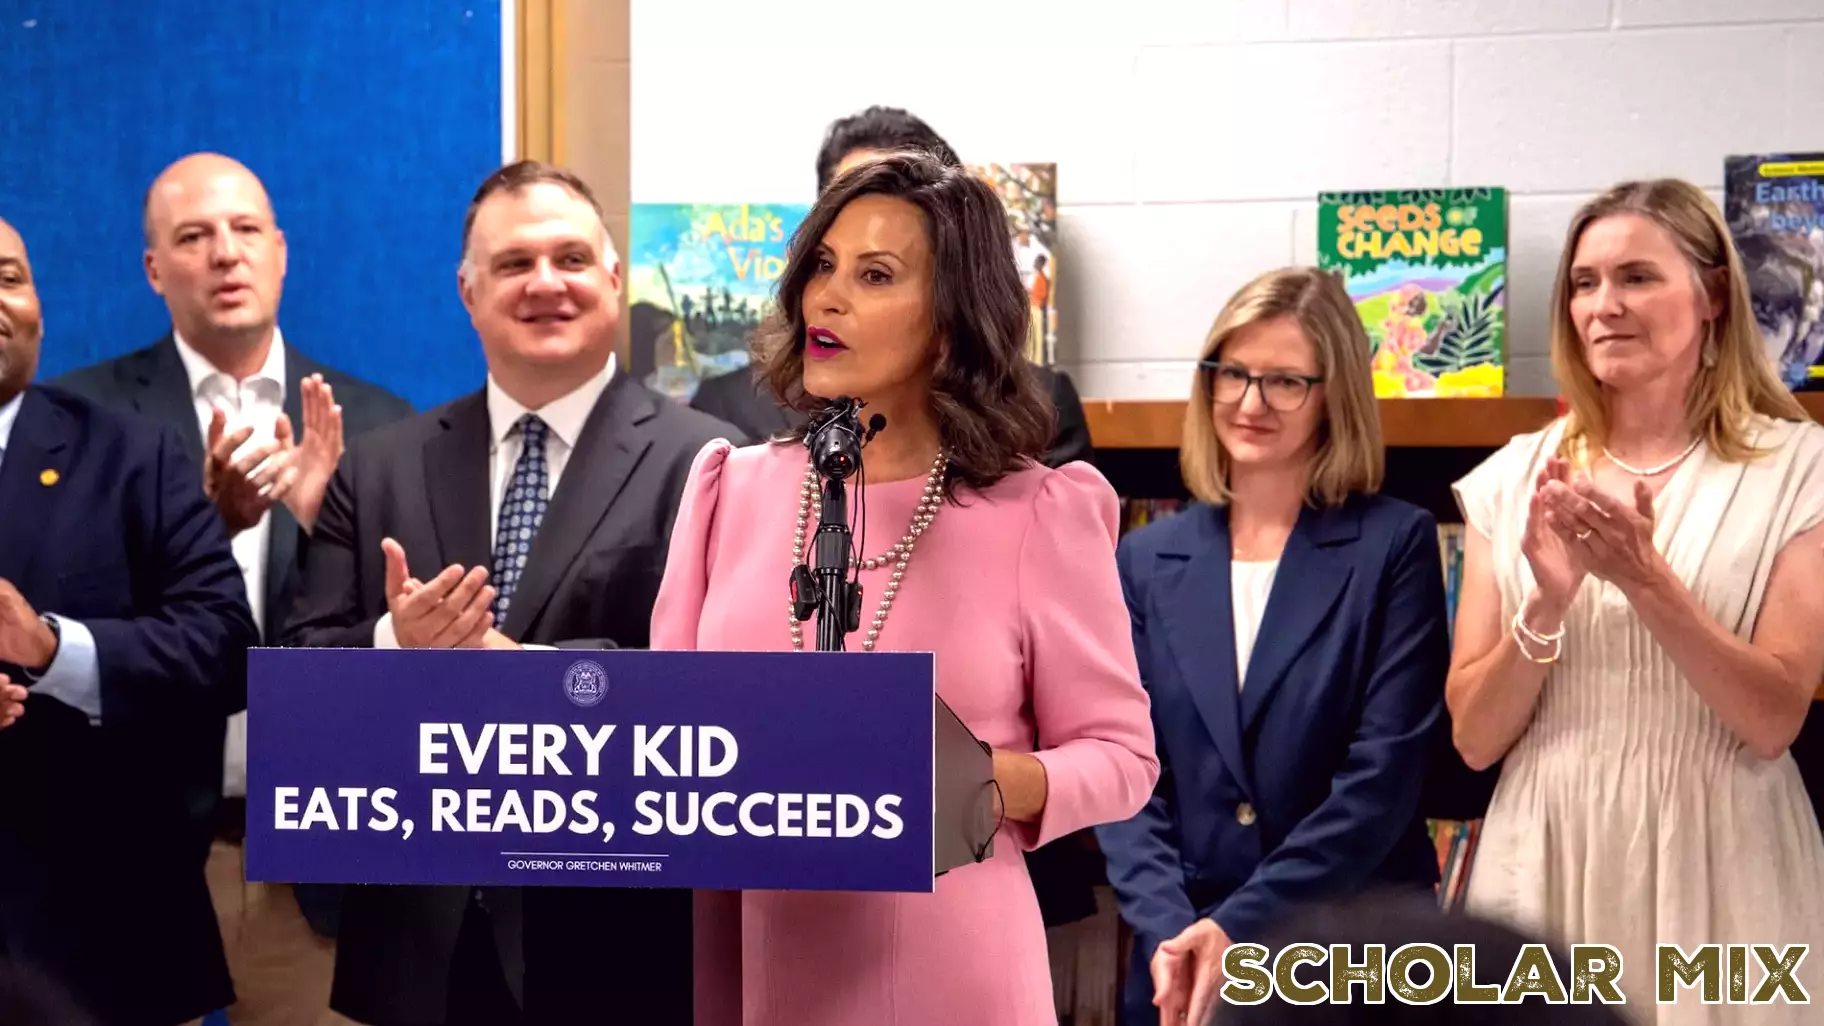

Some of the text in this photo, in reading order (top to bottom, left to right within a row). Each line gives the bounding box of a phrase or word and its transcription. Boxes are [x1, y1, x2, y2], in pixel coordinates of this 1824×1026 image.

[1755, 179, 1824, 203] Earth
[703, 203, 784, 243] Ada's
[727, 246, 790, 281] Vio
[419, 722, 739, 777] EVERY KID
[274, 786, 904, 843] EATS, READS, SUCCEEDS
[507, 859, 662, 872] GOVERNOR GRETCHEN WHITMER
